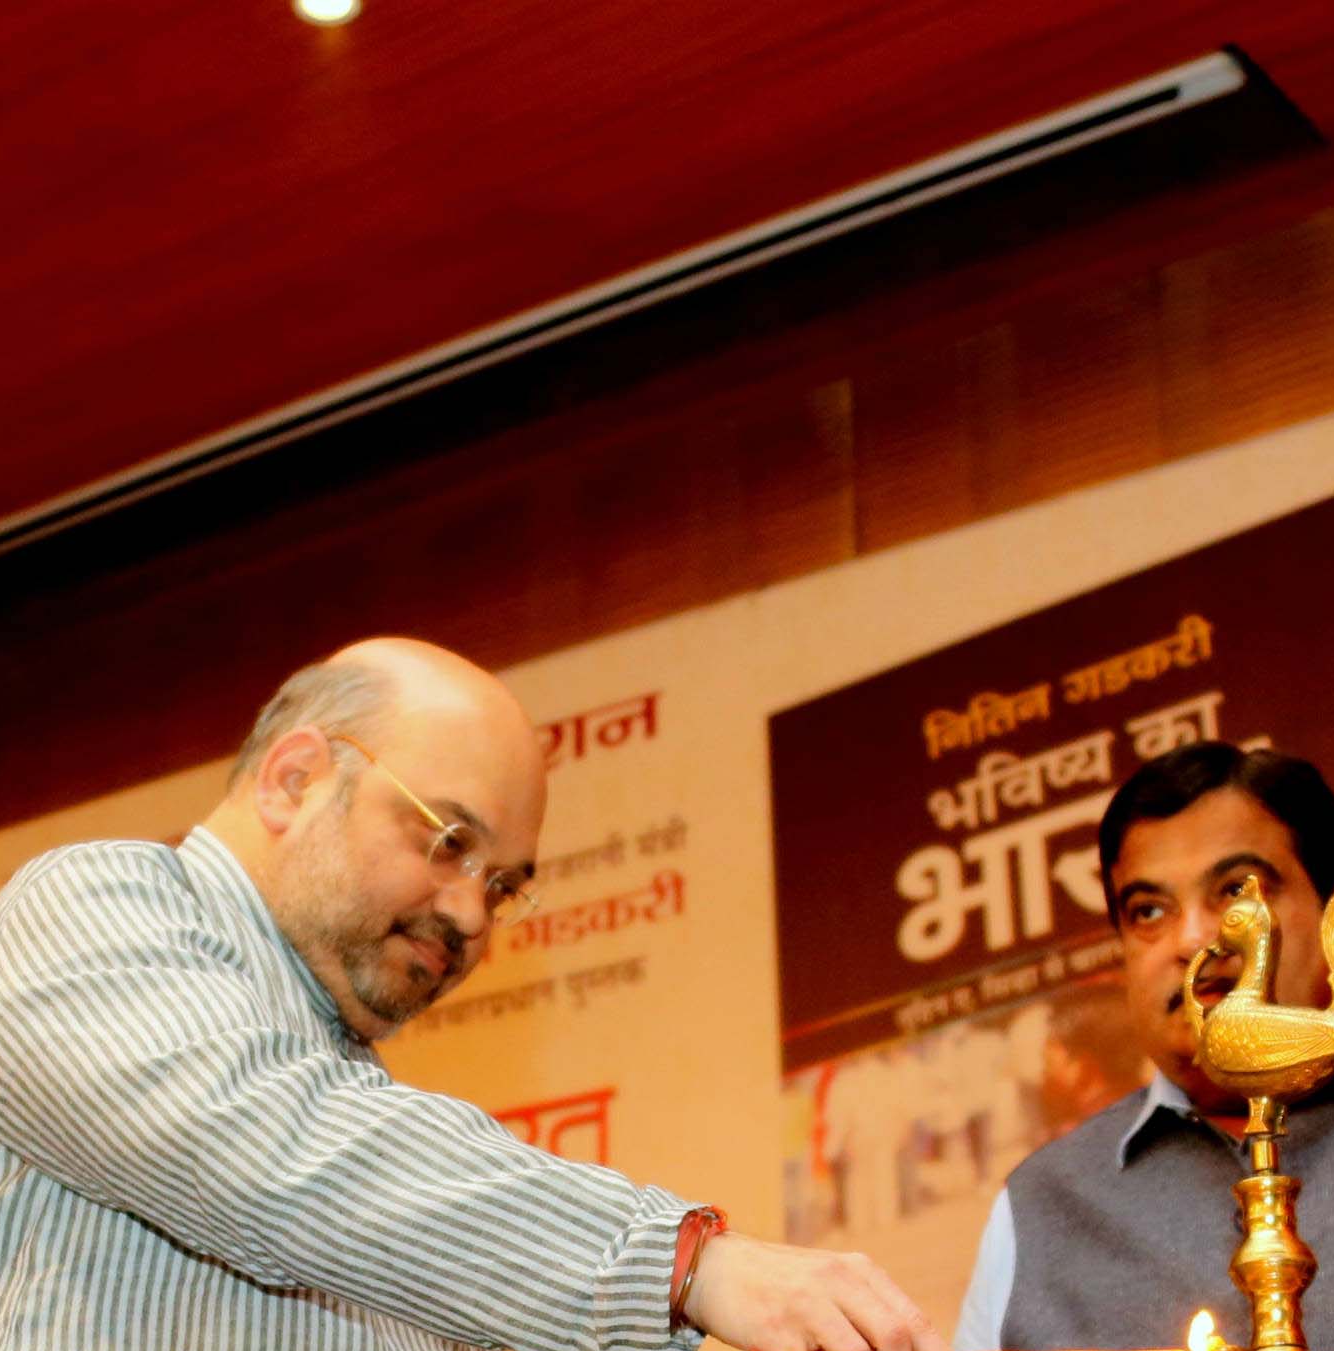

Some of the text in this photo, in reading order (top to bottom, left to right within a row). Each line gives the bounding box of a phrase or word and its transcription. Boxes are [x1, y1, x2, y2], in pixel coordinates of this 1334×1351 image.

[922, 613, 1213, 761] नितिन गडकरी
[926, 690, 1224, 830] भविष्य का
[509, 868, 686, 952] गडकरी
